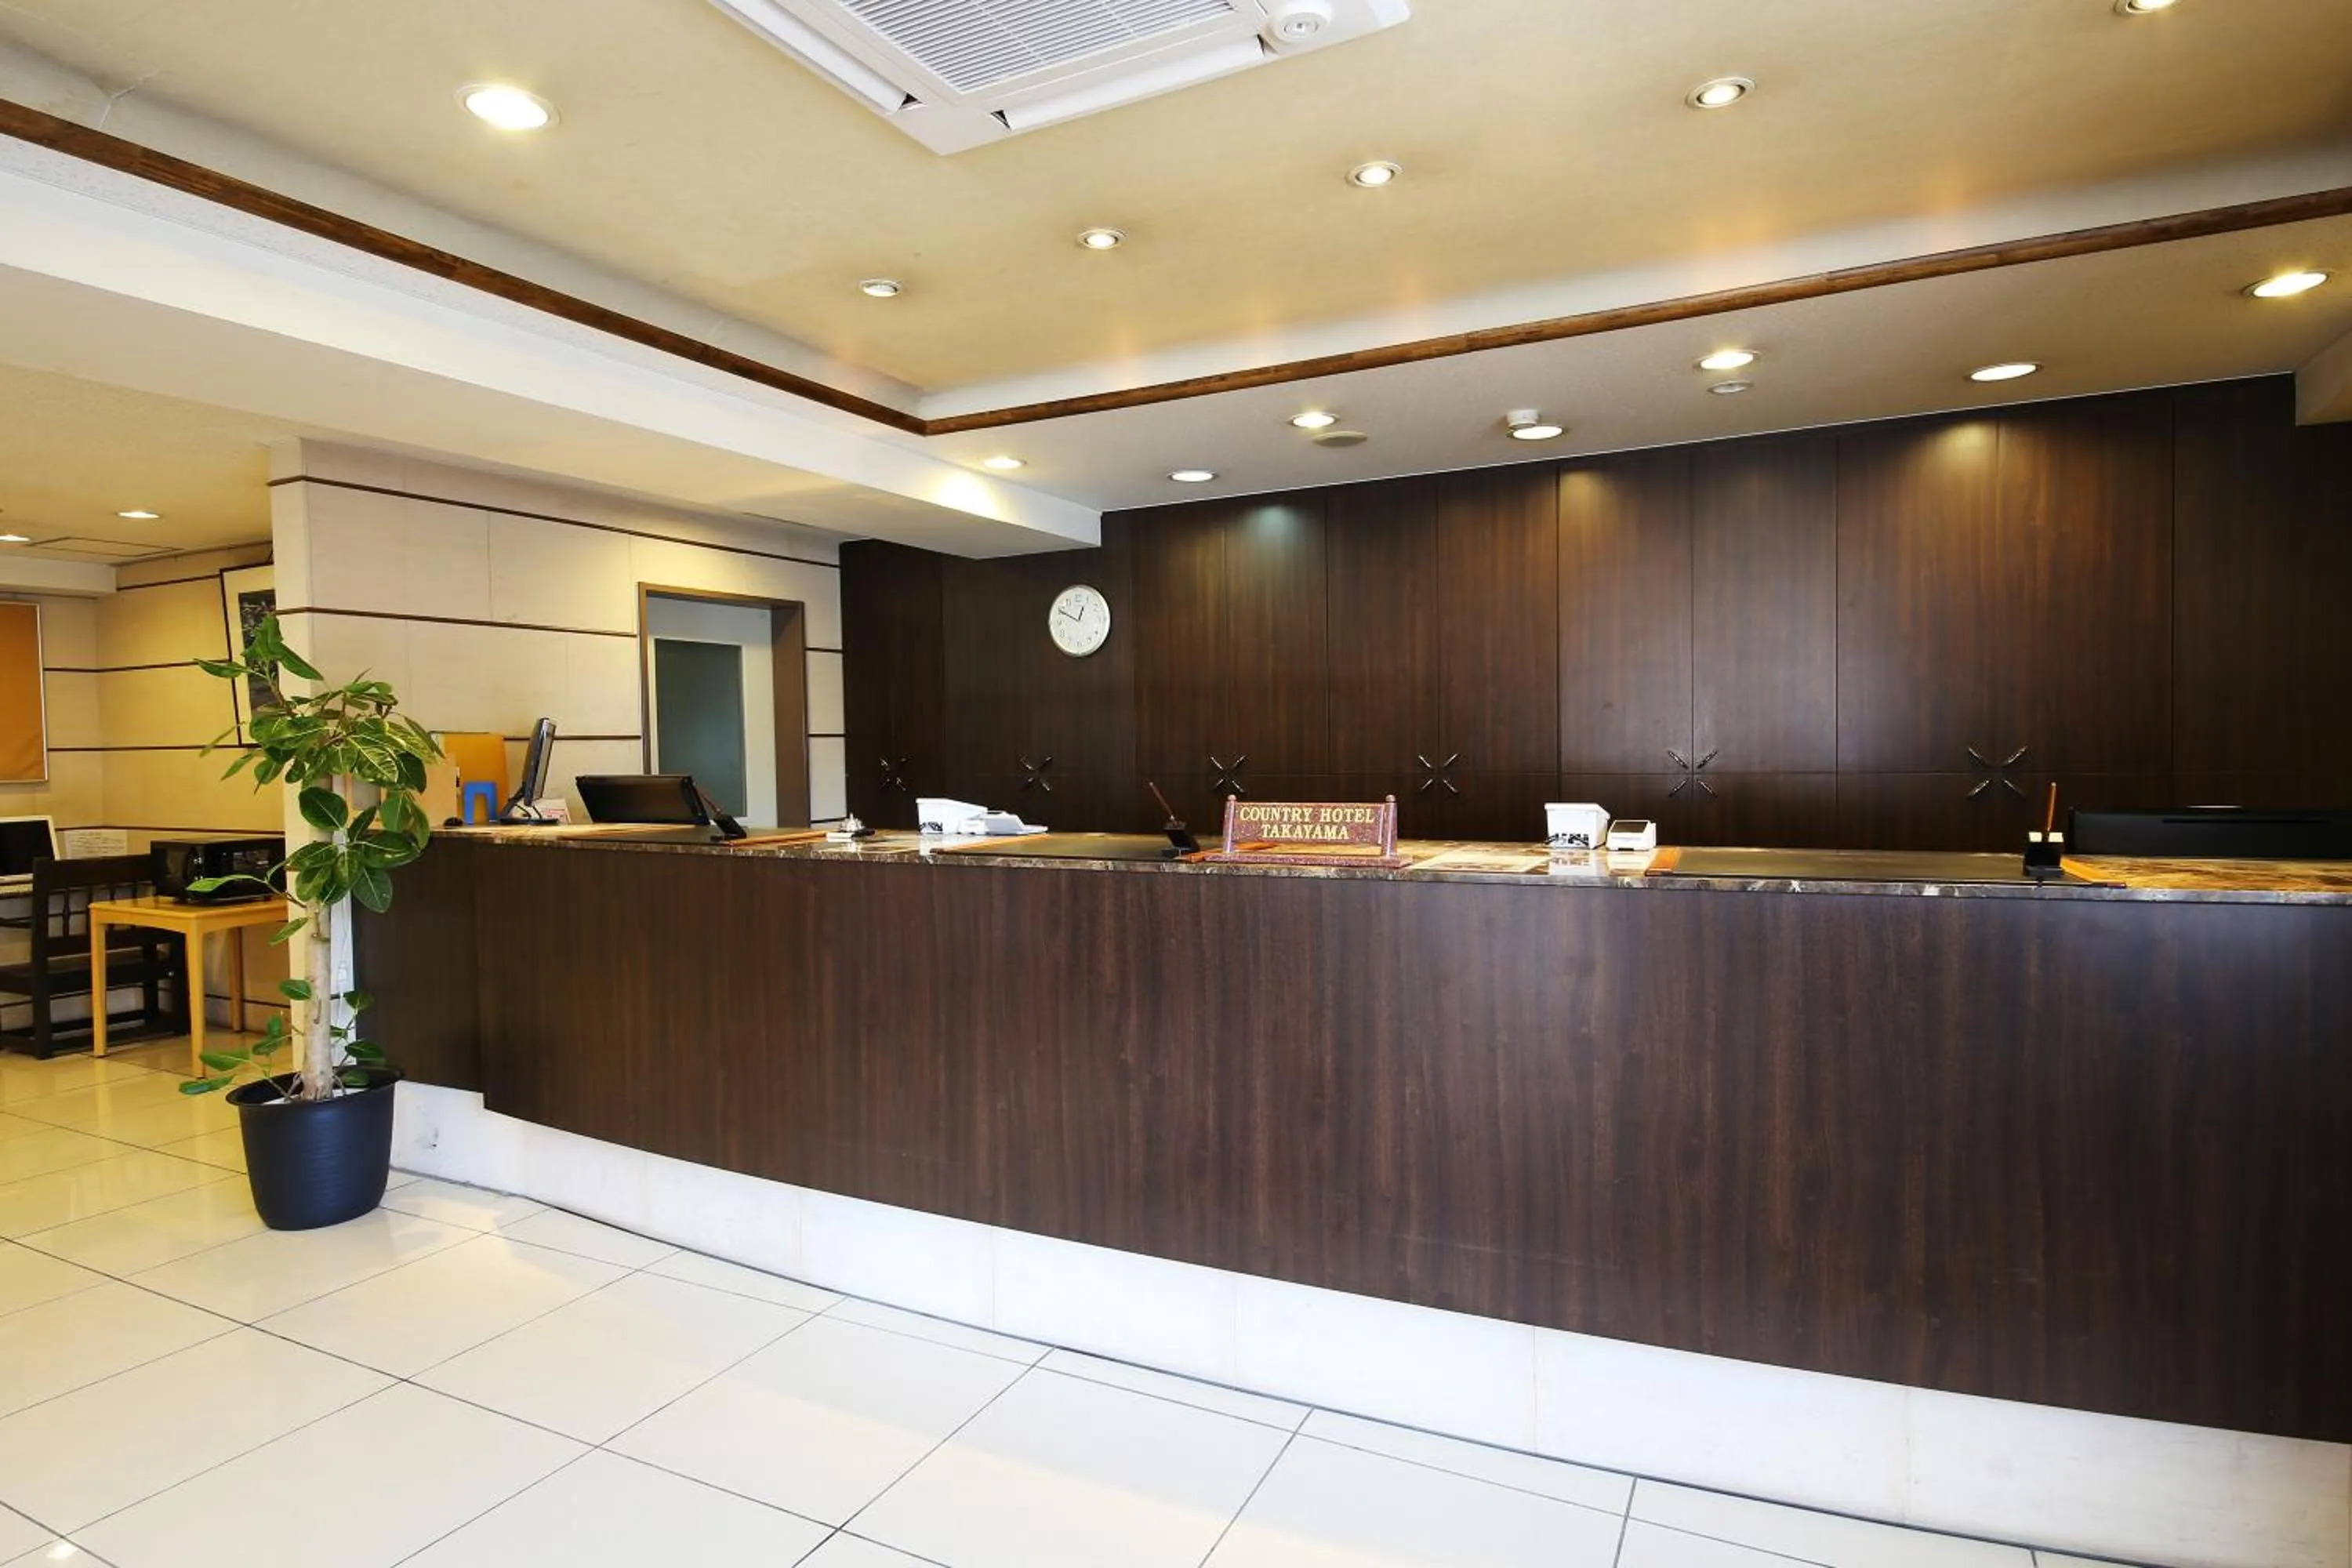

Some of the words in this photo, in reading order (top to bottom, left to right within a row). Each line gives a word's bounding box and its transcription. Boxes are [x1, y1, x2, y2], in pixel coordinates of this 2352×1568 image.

[1240, 807, 1313, 822] COUNTRY
[1320, 808, 1374, 823] HOTEL
[1261, 824, 1349, 840] TAKAYAMA
